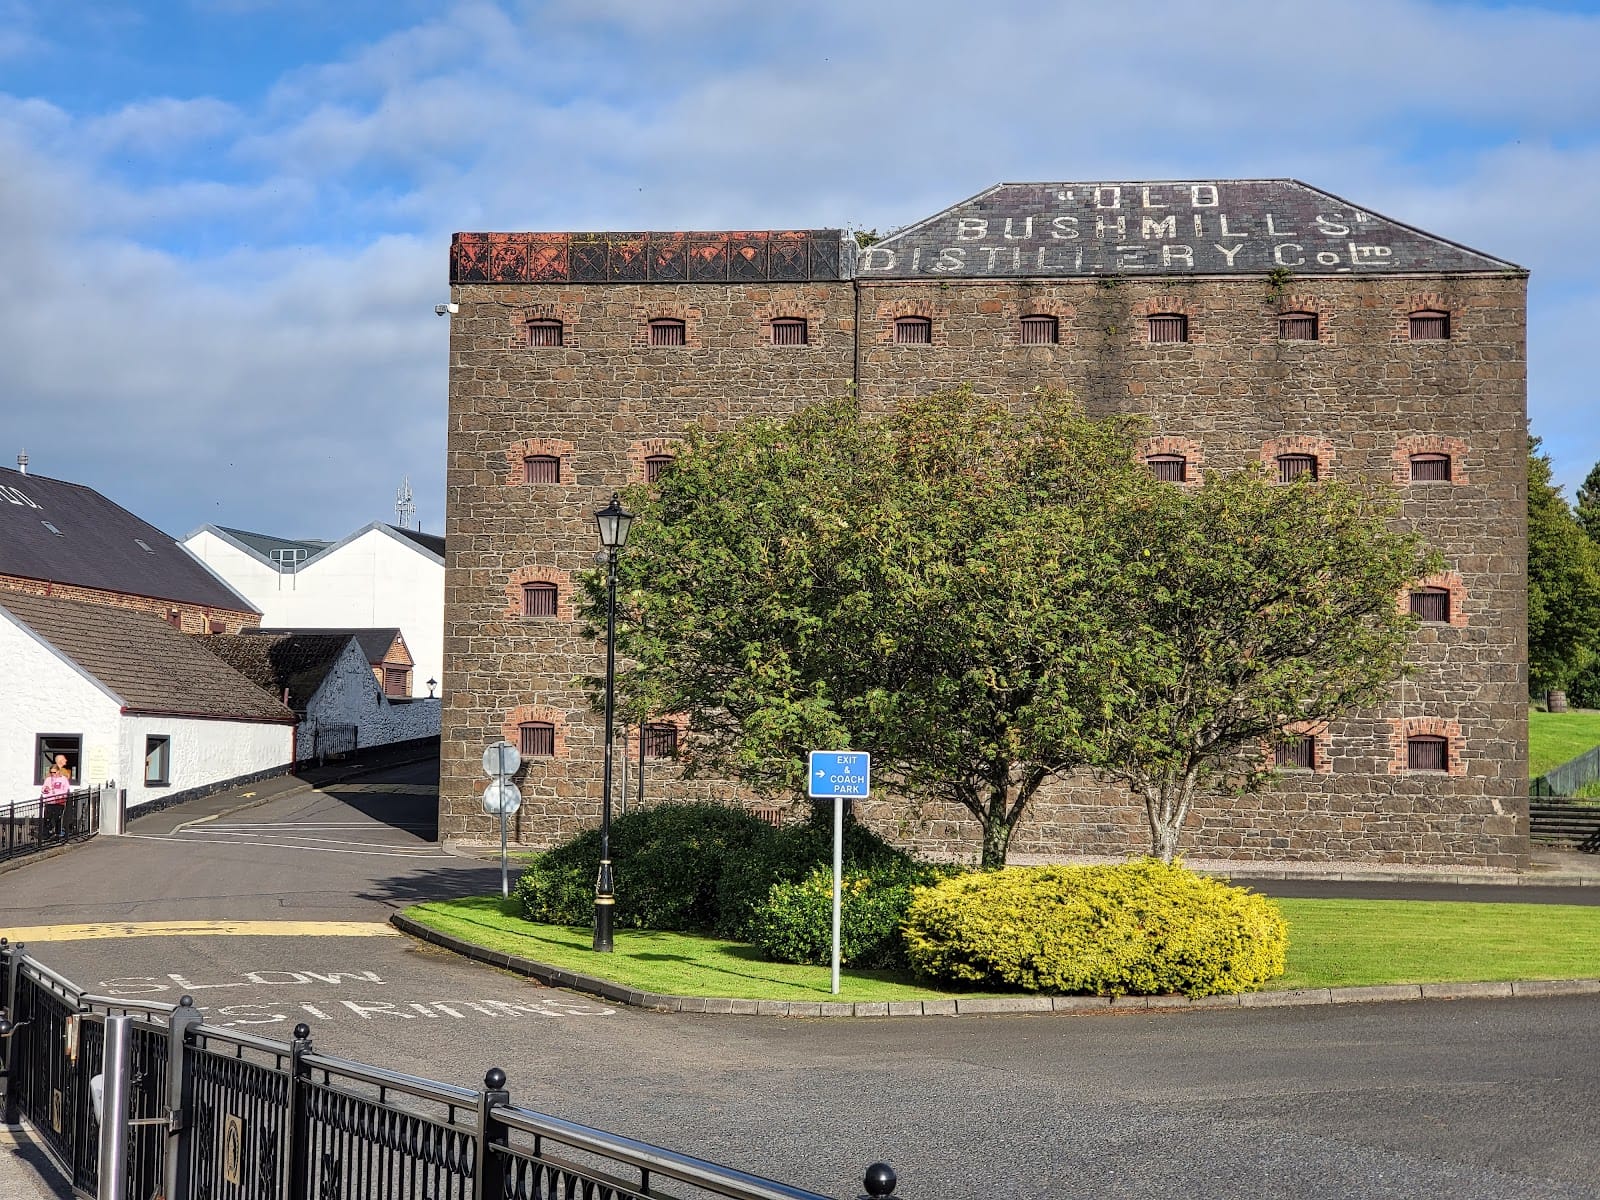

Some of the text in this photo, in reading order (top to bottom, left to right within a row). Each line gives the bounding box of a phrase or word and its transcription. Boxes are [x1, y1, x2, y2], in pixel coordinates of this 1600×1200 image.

[862, 243, 1244, 272] DISTILLERY
[836, 755, 857, 765] EXIT
[843, 765, 851, 774] &
[830, 774, 865, 784] COACH
[833, 784, 860, 794] PARK
[99, 970, 388, 995] SLOW
